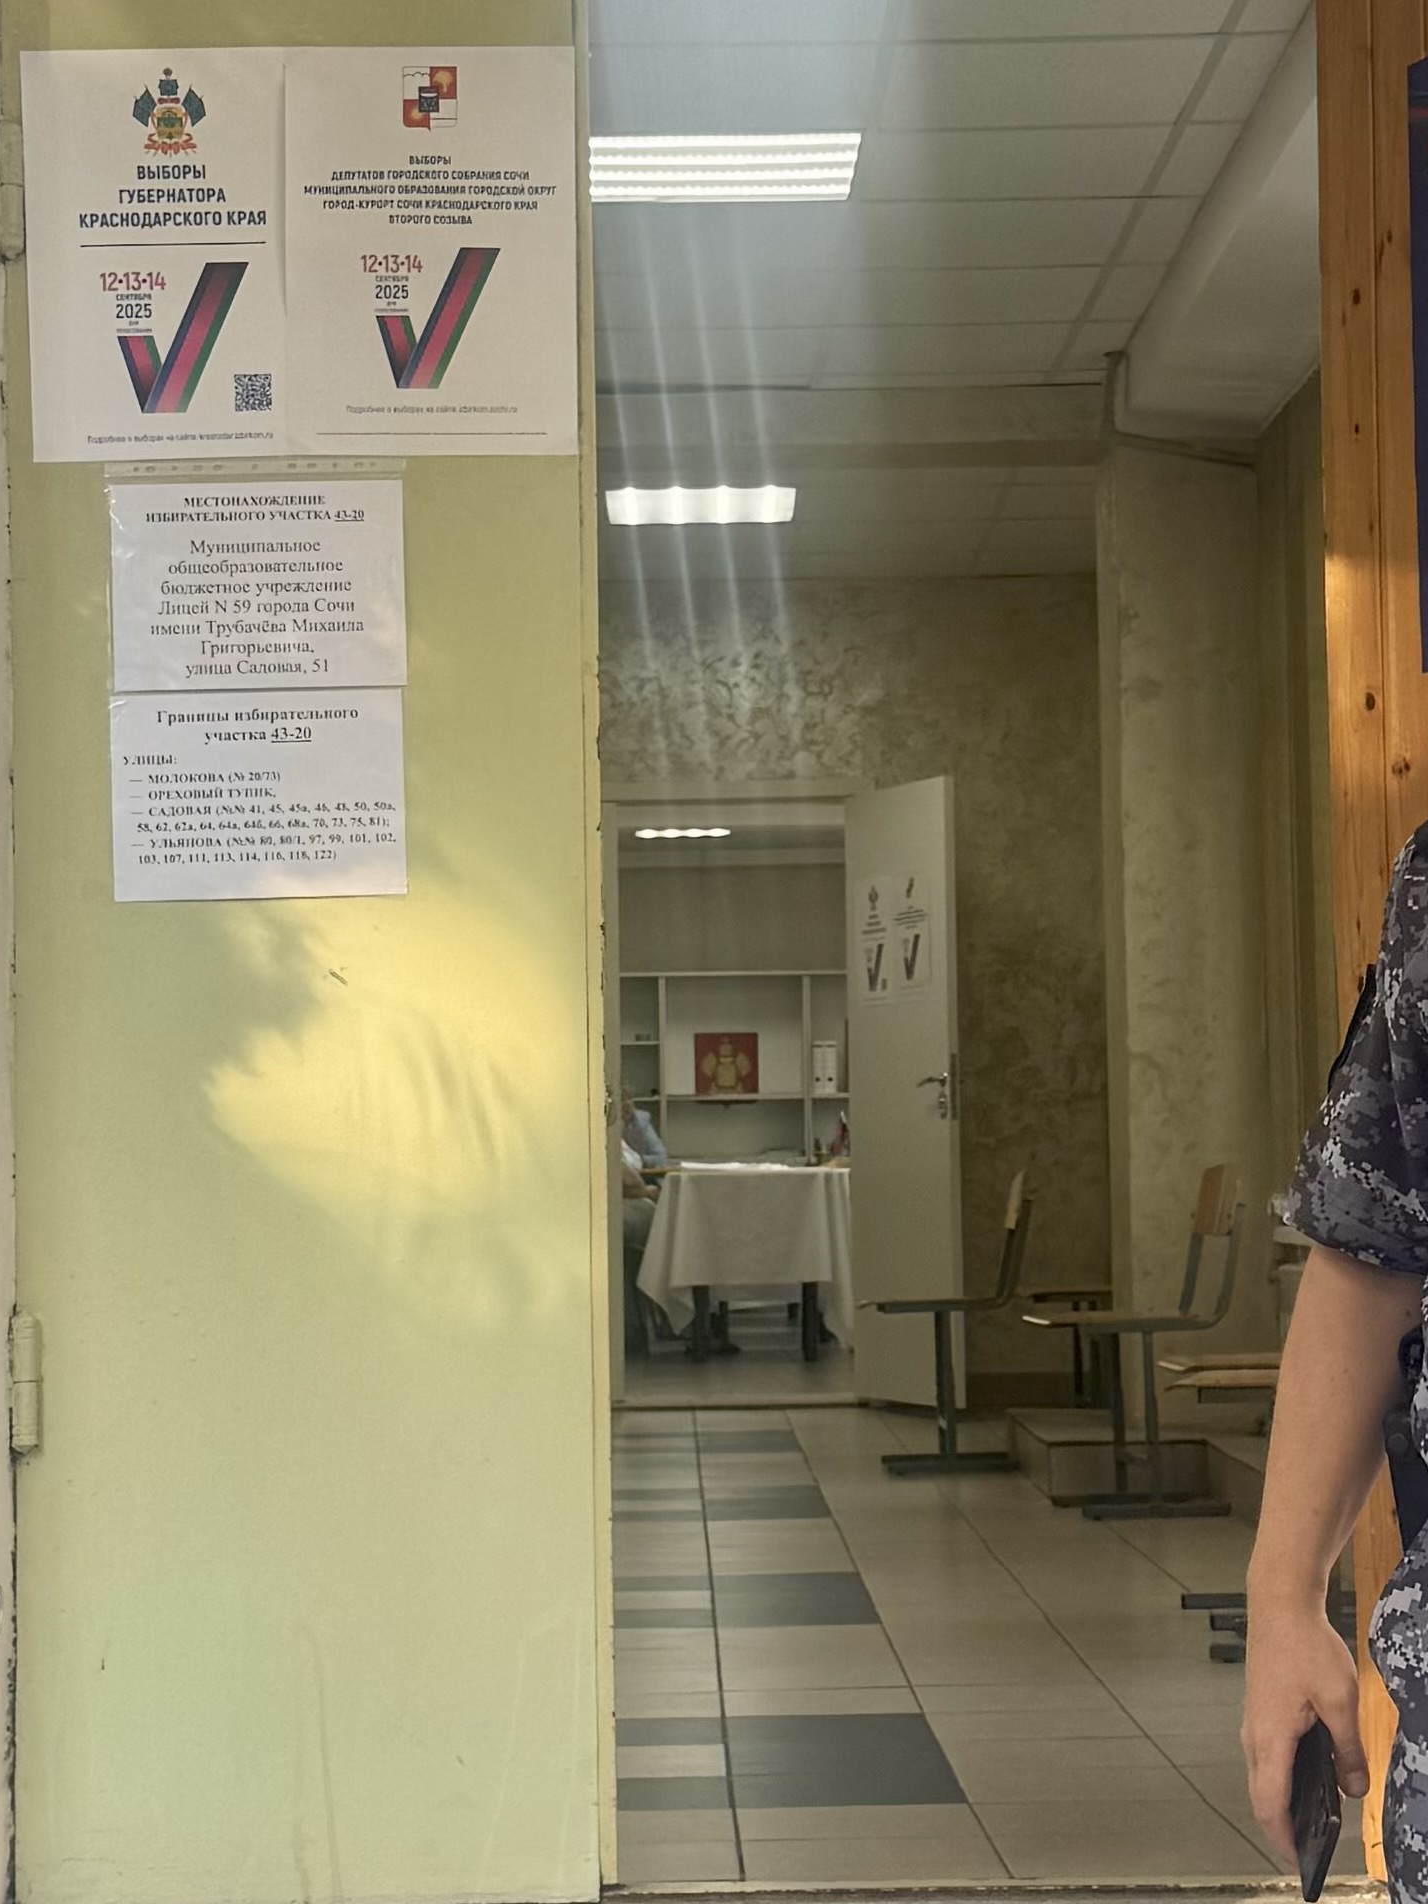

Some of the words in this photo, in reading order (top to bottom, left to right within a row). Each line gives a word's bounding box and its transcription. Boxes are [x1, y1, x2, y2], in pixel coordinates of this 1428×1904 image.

[409, 156, 451, 165] ВЫБОРЫ
[137, 165, 206, 180] ВЫБОРЫ
[331, 171, 384, 181] ДЕПУТАТОВ
[388, 170, 448, 180] ГОРОДСКОГО
[452, 171, 501, 180] СОБРАНИЯ
[504, 171, 529, 180] СОЧИ
[119, 188, 226, 204] ГУБЕРНАТОРА
[304, 185, 395, 196] МУНИЦИПАЛЬНОГО
[398, 185, 465, 194] ОБРАЗОВАНИЯ
[469, 184, 524, 196] ГОРОДСКОЙ
[528, 186, 557, 195] ОКРУГ
[324, 200, 394, 210] ГОРОД-КУРОРТ
[397, 200, 422, 208] СОЧИ
[425, 200, 511, 211] КРАСНОДАРСКОГО
[514, 201, 537, 210] КРАЯ
[79, 212, 222, 229] КРАСНОДАРСКОГО
[228, 211, 266, 225] КРАЯ
[389, 215, 431, 224] ВТОРОГО
[434, 215, 472, 224] СОЗЫВА
[375, 285, 409, 299] 2025
[116, 304, 152, 318] 2025
[184, 495, 325, 508] МЕСТОНАХОЖДЕНИЕ
[146, 511, 265, 523] ИЗБИРАТЕЛЬНОГО
[269, 510, 331, 521] УЧАСТКА
[335, 510, 364, 522] 43-20
[190, 540, 321, 556] Муниципальное
[169, 560, 343, 577] общеобразовательное
[161, 581, 250, 594] бюджетное
[256, 581, 351, 596] учреждение
[158, 601, 209, 615] Лицей
[215, 601, 227, 613] N
[234, 600, 250, 613] 59
[257, 602, 308, 615] города
[315, 599, 354, 612] Сочи
[151, 624, 200, 635] имени
[206, 620, 286, 637] Трубачёва
[292, 619, 364, 632] Михаила
[201, 641, 314, 658] Григорьевича,
[186, 663, 231, 678] улица
[237, 660, 307, 675] Садовая,
[312, 659, 329, 672] 51
[157, 711, 228, 726] Границы
[235, 709, 358, 723] избирательного
[205, 731, 266, 744] участка
[271, 727, 311, 743] 43-20
[148, 773, 224, 784] МОЛОКОВА
[149, 787, 222, 800] ОРЕХОВЫЙ
[149, 806, 211, 816] САДОВАЯ
[150, 838, 222, 848] УЛЬЯНОВА
